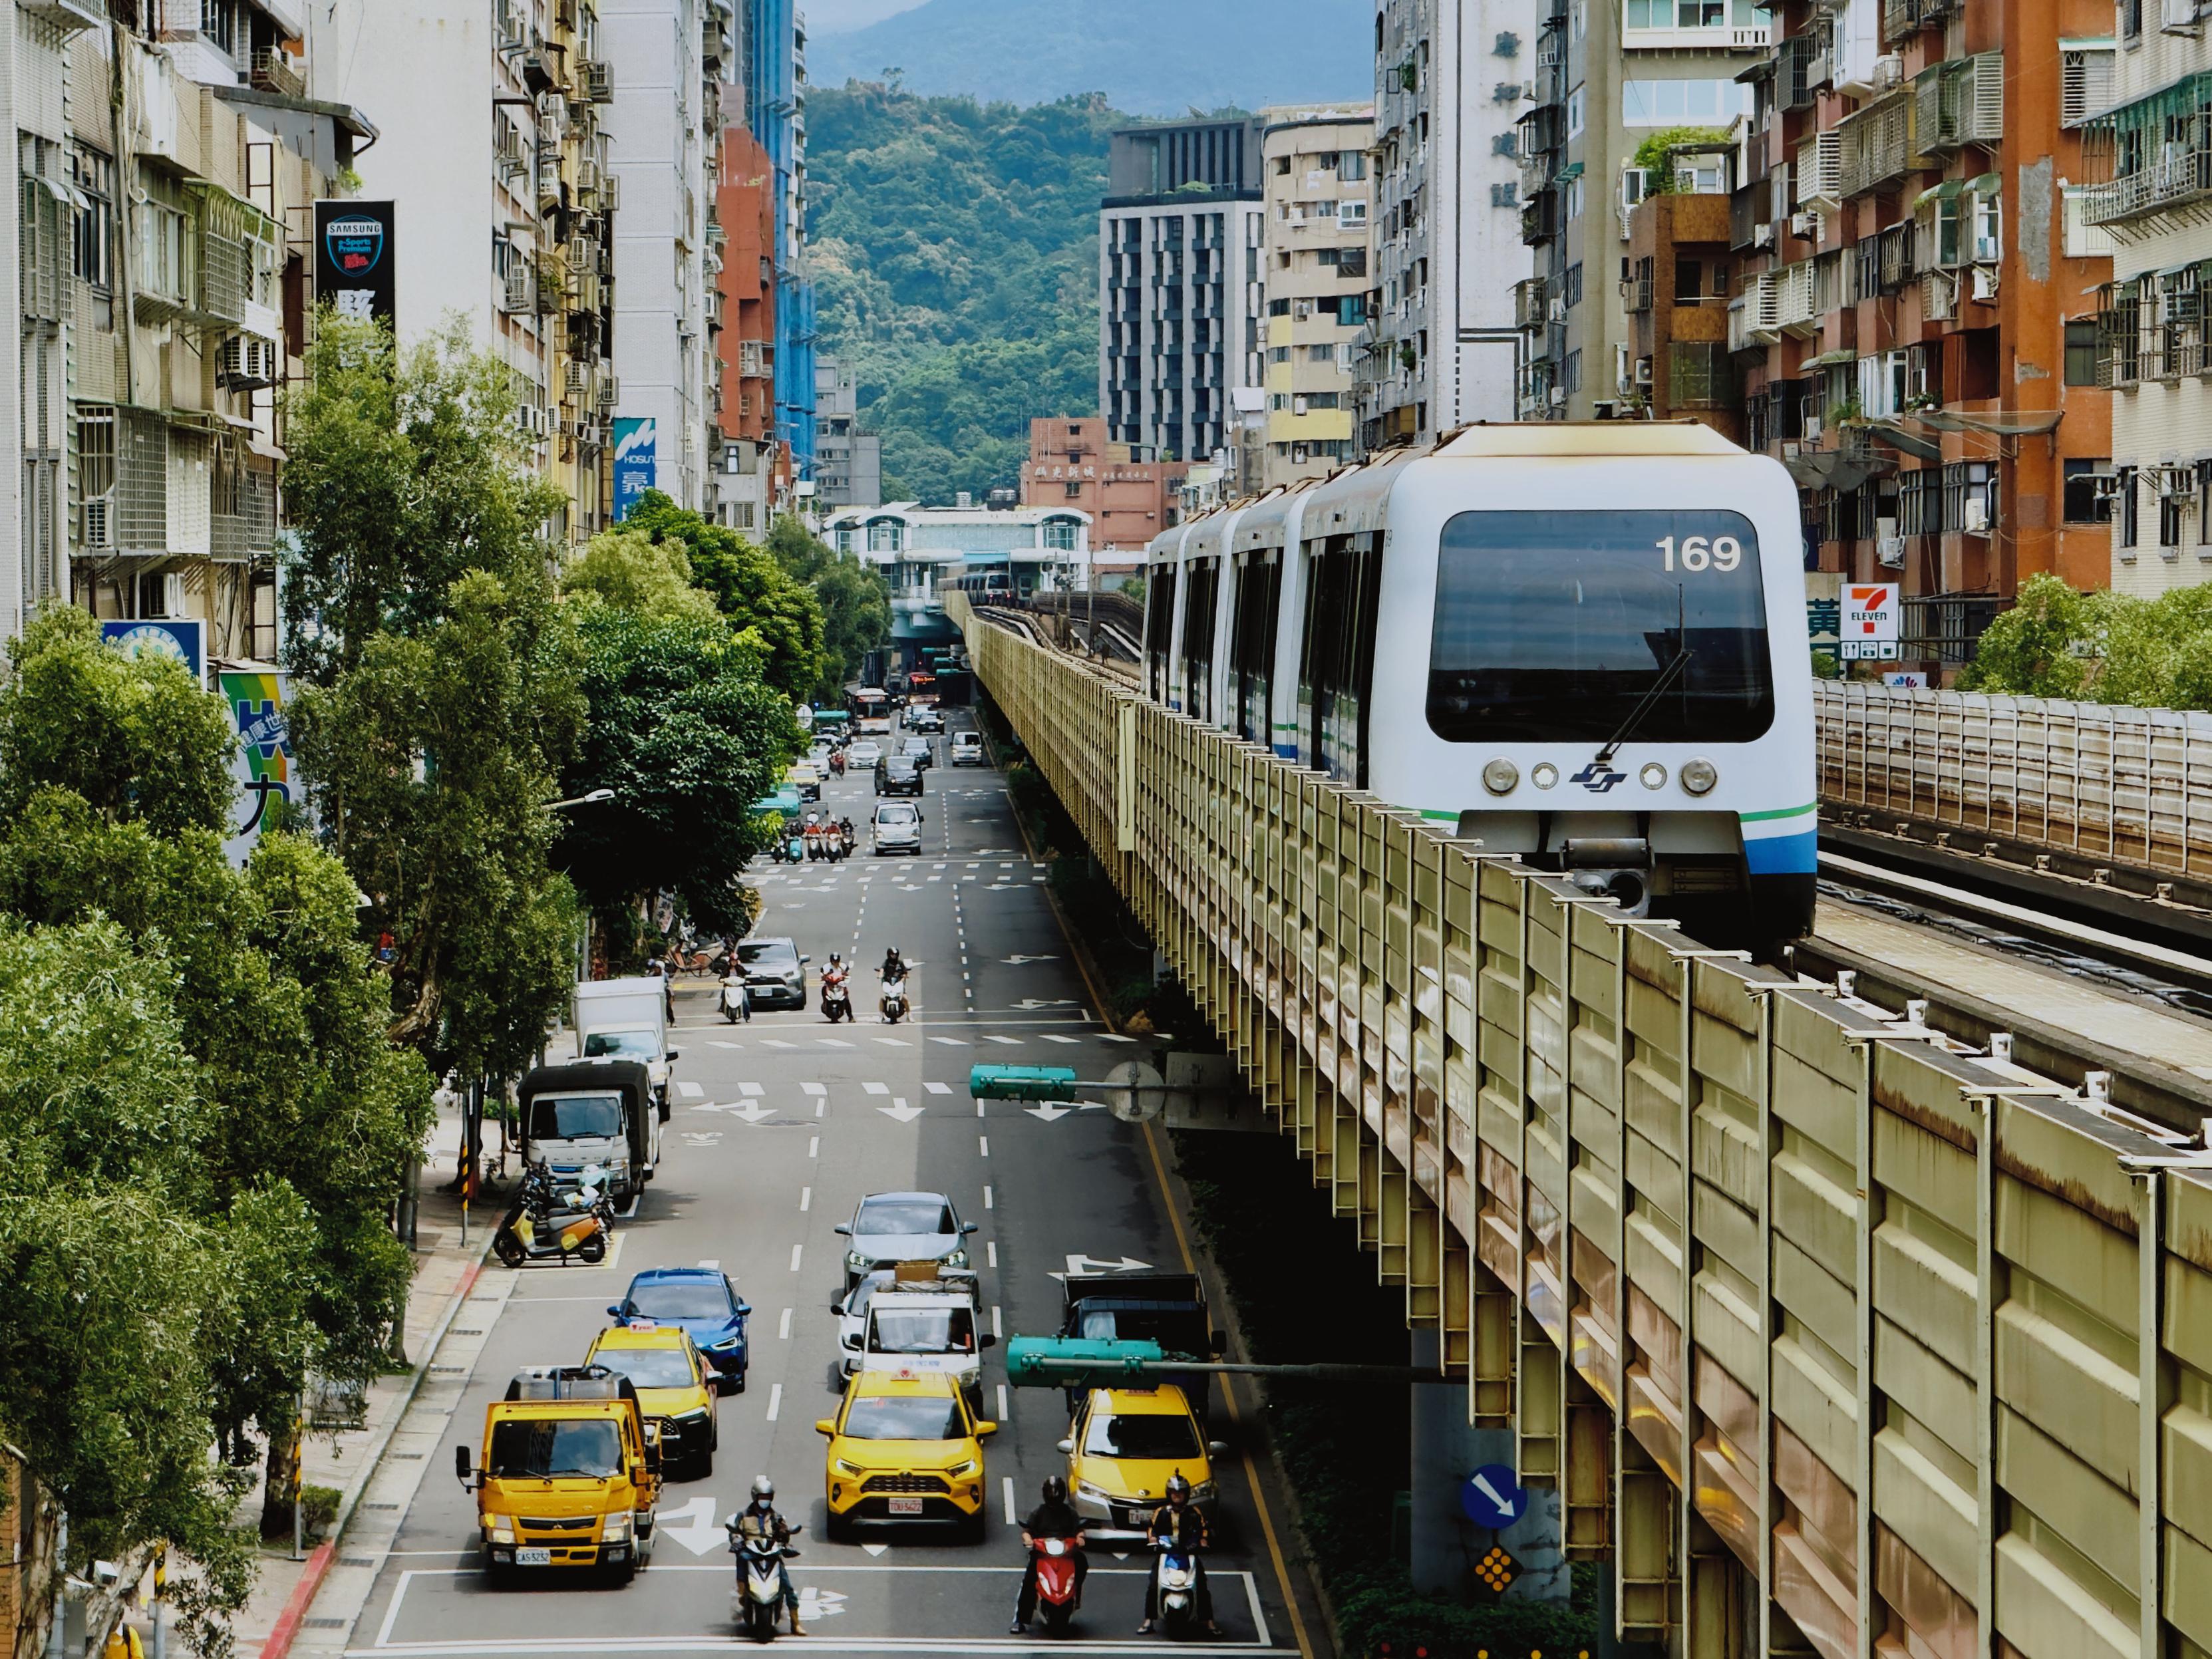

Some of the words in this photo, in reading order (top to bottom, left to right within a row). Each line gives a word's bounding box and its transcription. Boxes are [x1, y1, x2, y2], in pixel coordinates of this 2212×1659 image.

[329, 225, 380, 233] SAMSUNG
[1656, 536, 1741, 571] 169
[239, 712, 287, 753] 健康世
